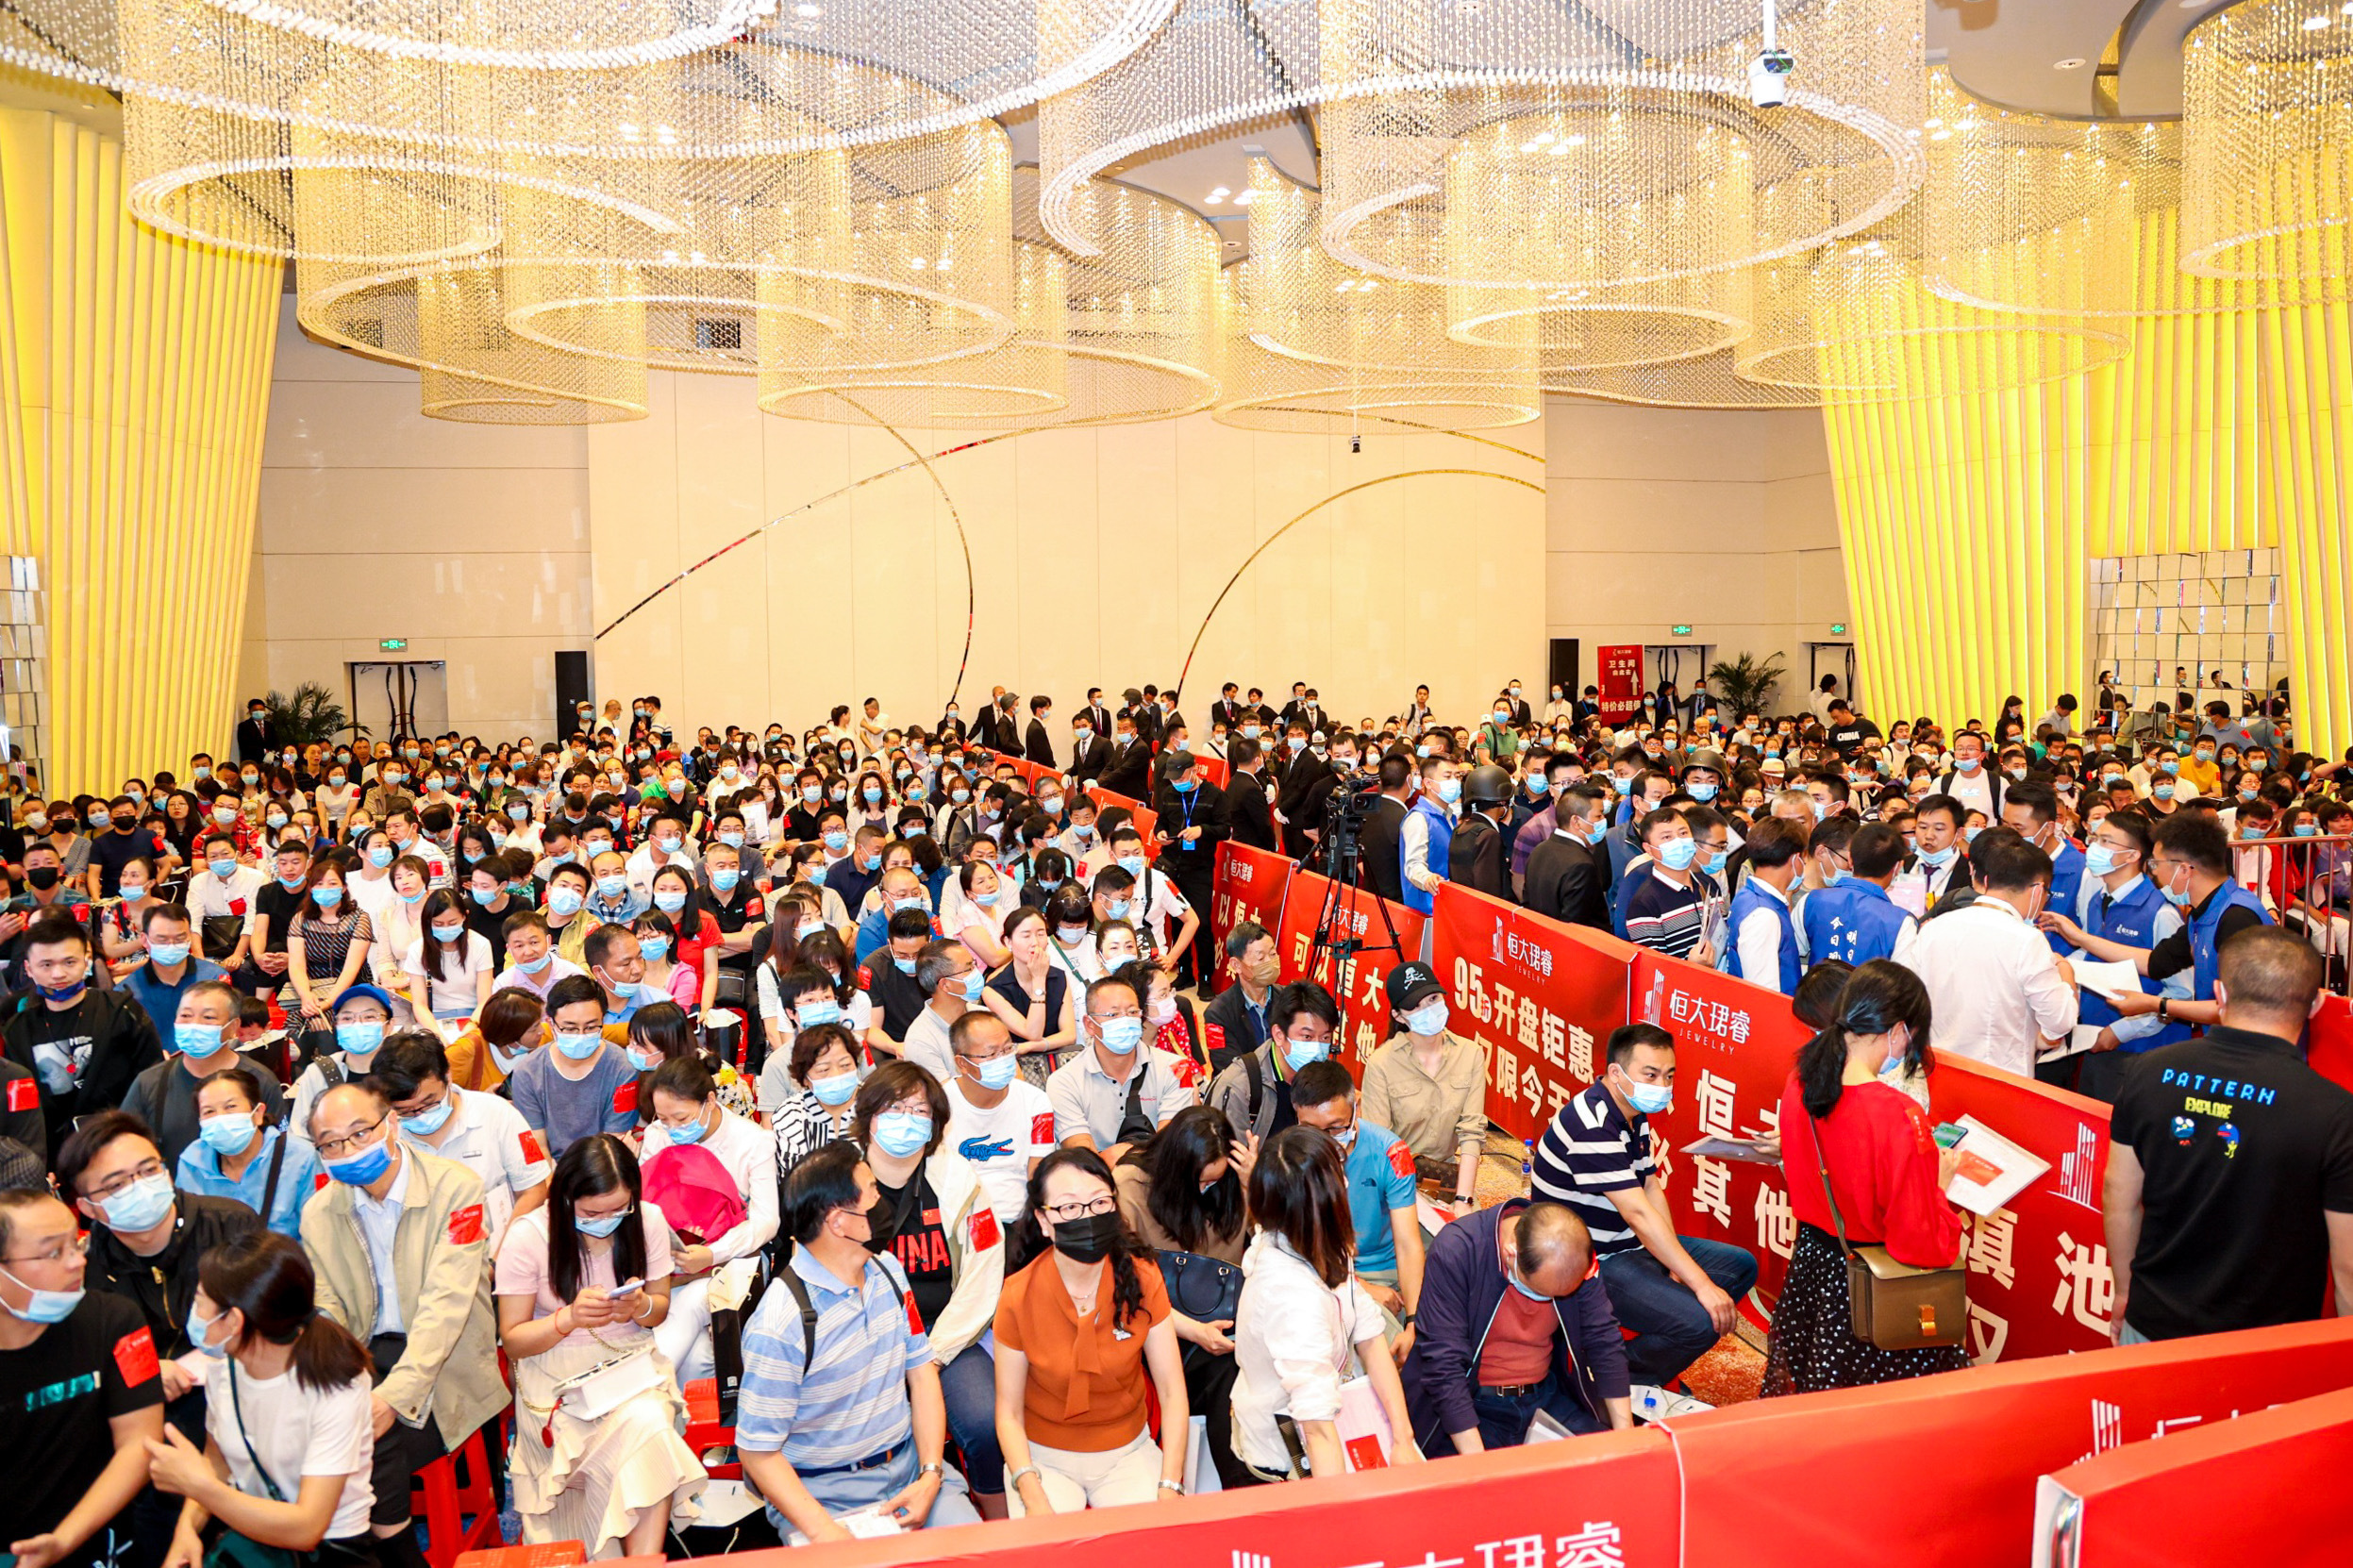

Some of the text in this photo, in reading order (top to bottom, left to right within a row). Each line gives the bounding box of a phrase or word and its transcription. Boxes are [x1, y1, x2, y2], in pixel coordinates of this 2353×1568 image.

[1609, 659, 1636, 669] 卫生间
[1837, 731, 1861, 742] CHINA
[1508, 931, 1553, 977] 恒大珺睿
[1514, 963, 1546, 986] JEWELRY
[1669, 988, 1751, 1045] 恒大珺睿
[1678, 1027, 1736, 1056] JEWELRY
[2161, 1068, 2277, 1106] PATTERN
[2184, 1096, 2233, 1120] EXPLORE
